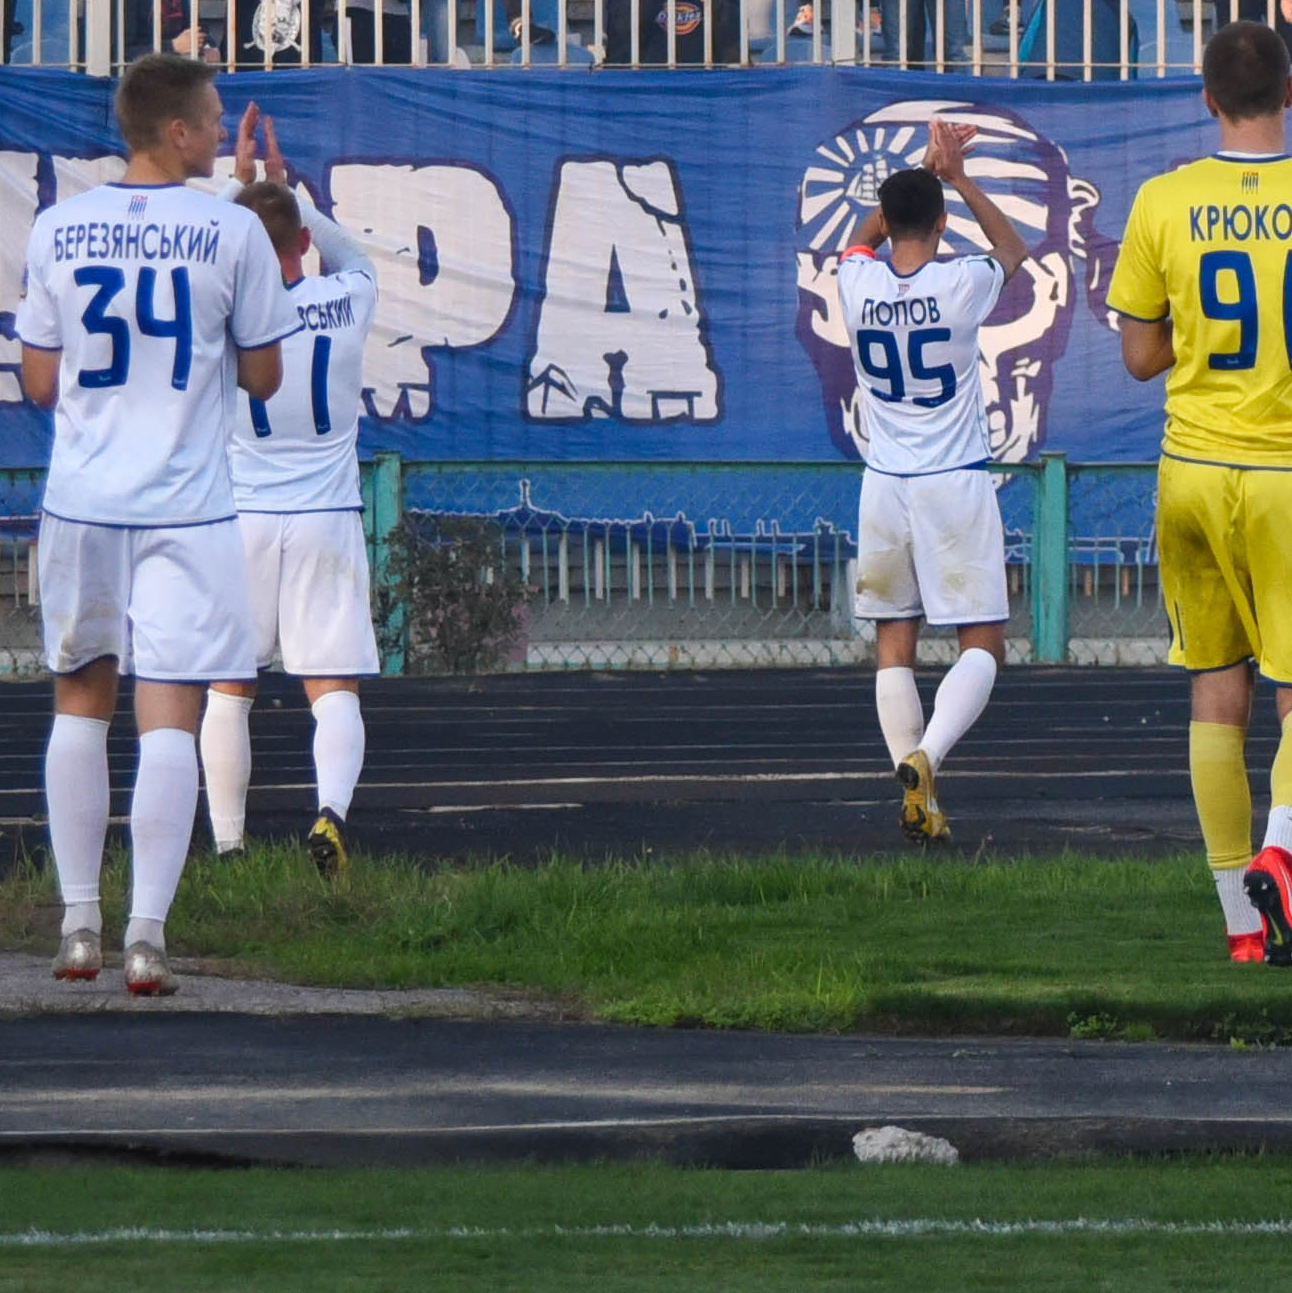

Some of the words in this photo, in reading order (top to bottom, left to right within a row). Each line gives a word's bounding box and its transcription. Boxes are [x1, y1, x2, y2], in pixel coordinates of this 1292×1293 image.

[53, 221, 221, 265] БЕРЕЗЯНСЬКИЙ
[74, 265, 193, 391] 34
[861, 296, 941, 326] ПОПОВ
[857, 328, 957, 408] 95
